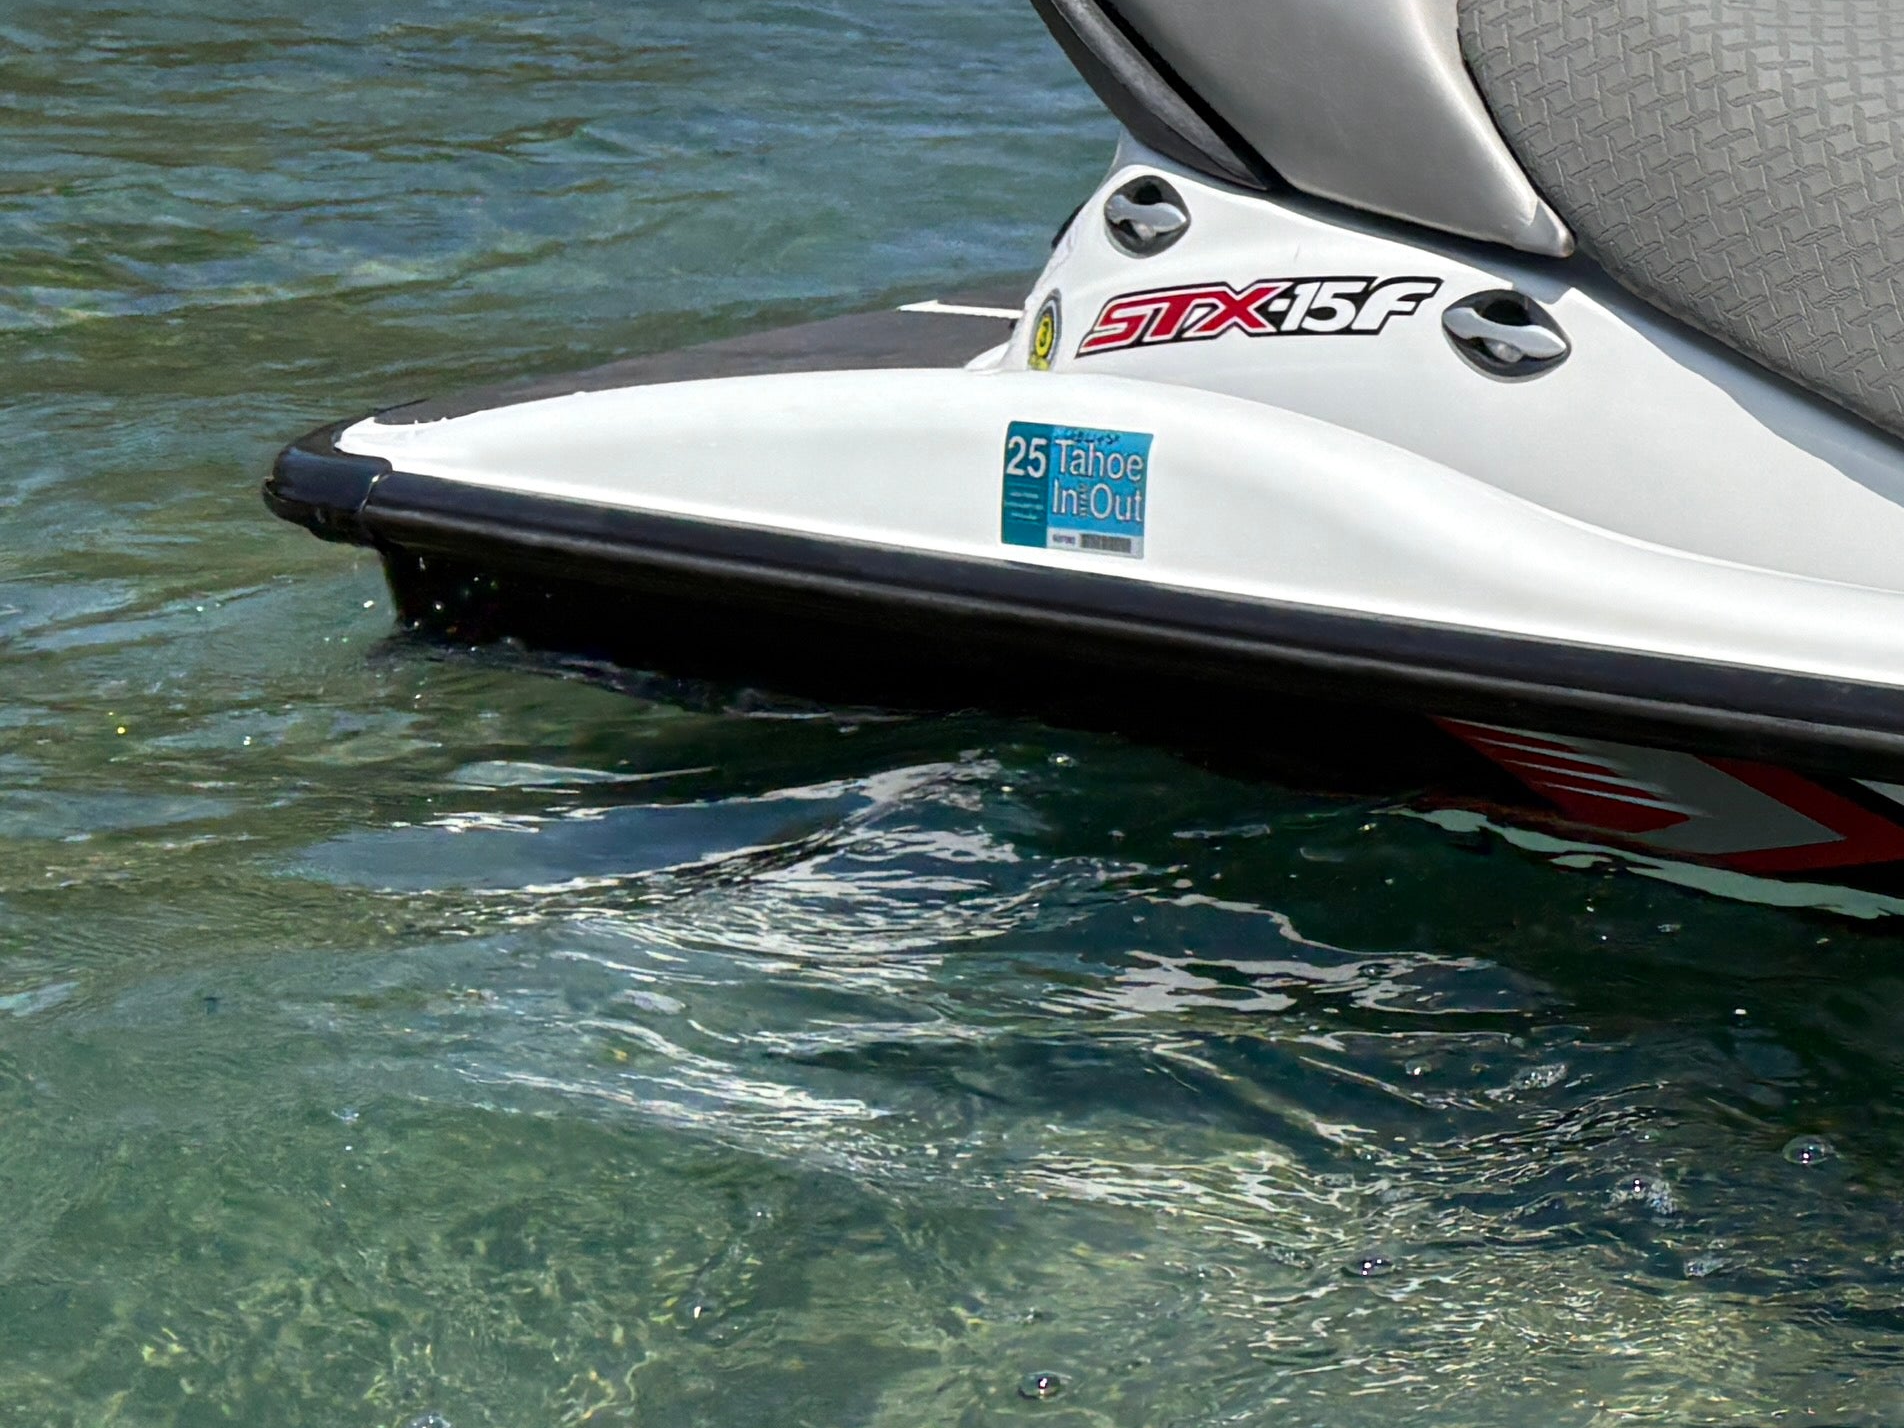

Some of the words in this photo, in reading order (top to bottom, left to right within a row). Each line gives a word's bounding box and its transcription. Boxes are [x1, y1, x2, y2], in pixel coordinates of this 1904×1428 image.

[1006, 435, 1048, 479] 25
[1055, 438, 1144, 482] Tahoe
[1052, 479, 1078, 514] In
[1090, 483, 1144, 521] Out
